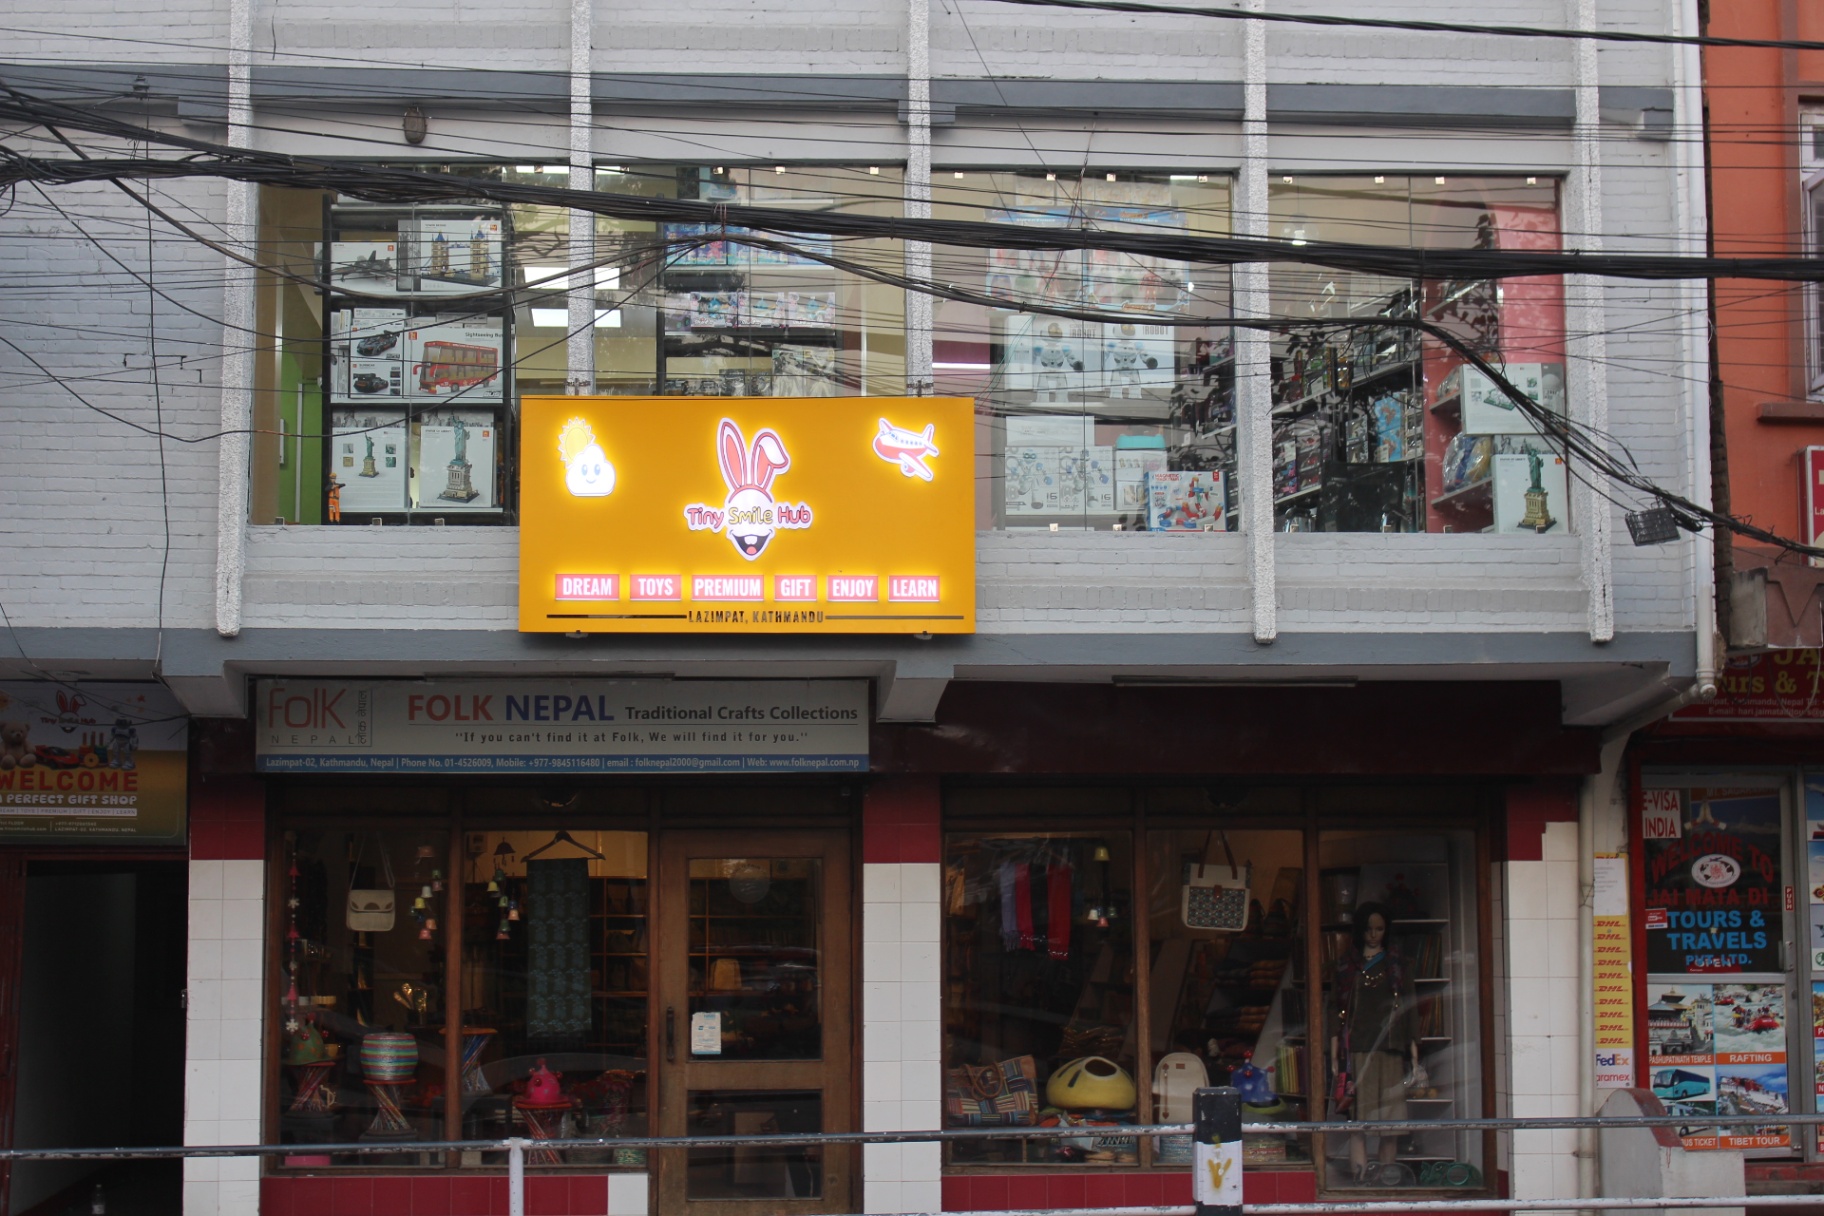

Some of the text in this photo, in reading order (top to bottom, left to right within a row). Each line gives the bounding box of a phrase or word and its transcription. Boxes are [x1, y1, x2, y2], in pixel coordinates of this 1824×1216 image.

[687, 505, 811, 529] Tiny Smile Hub
[562, 578, 938, 597] DREAM TOYS PREMIUM GIFT ENJOY LEARN
[688, 610, 824, 624] LAZIMPAT, KATHMANDU
[1775, 670, 1798, 694] &
[408, 694, 858, 721] FOLK NEPAL Traditional Crafts Collections
[271, 735, 354, 744] NEPAL
[480, 734, 502, 744] you
[508, 732, 541, 743] can't
[547, 732, 572, 742] find
[578, 732, 587, 742] it
[593, 732, 606, 742] at
[612, 732, 644, 744] Folk,
[649, 732, 667, 742] We
[673, 732, 696, 742] will
[702, 732, 727, 742] find
[733, 732, 742, 742] it
[748, 732, 767, 742] for
[266, 757, 318, 768] Lazimpat-02,
[319, 757, 368, 768] Kathmandu,
[370, 757, 394, 768] Nepal
[401, 757, 427, 768] Phone
[428, 758, 443, 767] No.
[496, 758, 526, 767] Mobile:
[607, 757, 629, 767] email
[747, 757, 768, 767] Web:
[0, 770, 138, 792] WELCOME
[6, 793, 65, 805] PERFECT
[68, 794, 98, 805] GIFT
[101, 795, 138, 805] SHOP
[1645, 818, 1677, 838] INDIA
[1650, 832, 1745, 884] WELCOME
[1747, 844, 1775, 884] TO
[1648, 887, 1769, 906] JAI MATA DI
[1666, 910, 1742, 928] TOURS
[1749, 910, 1766, 928] &
[1666, 931, 1768, 951] TRAVELS
[1596, 1054, 1630, 1066] FedEx
[1649, 1054, 1712, 1064] PASHUPATINATH TEMPLE
[1729, 1053, 1772, 1063] RAFTING
[1694, 1137, 1716, 1146] TICKET
[1729, 1136, 1780, 1146] TIBET TOUR
